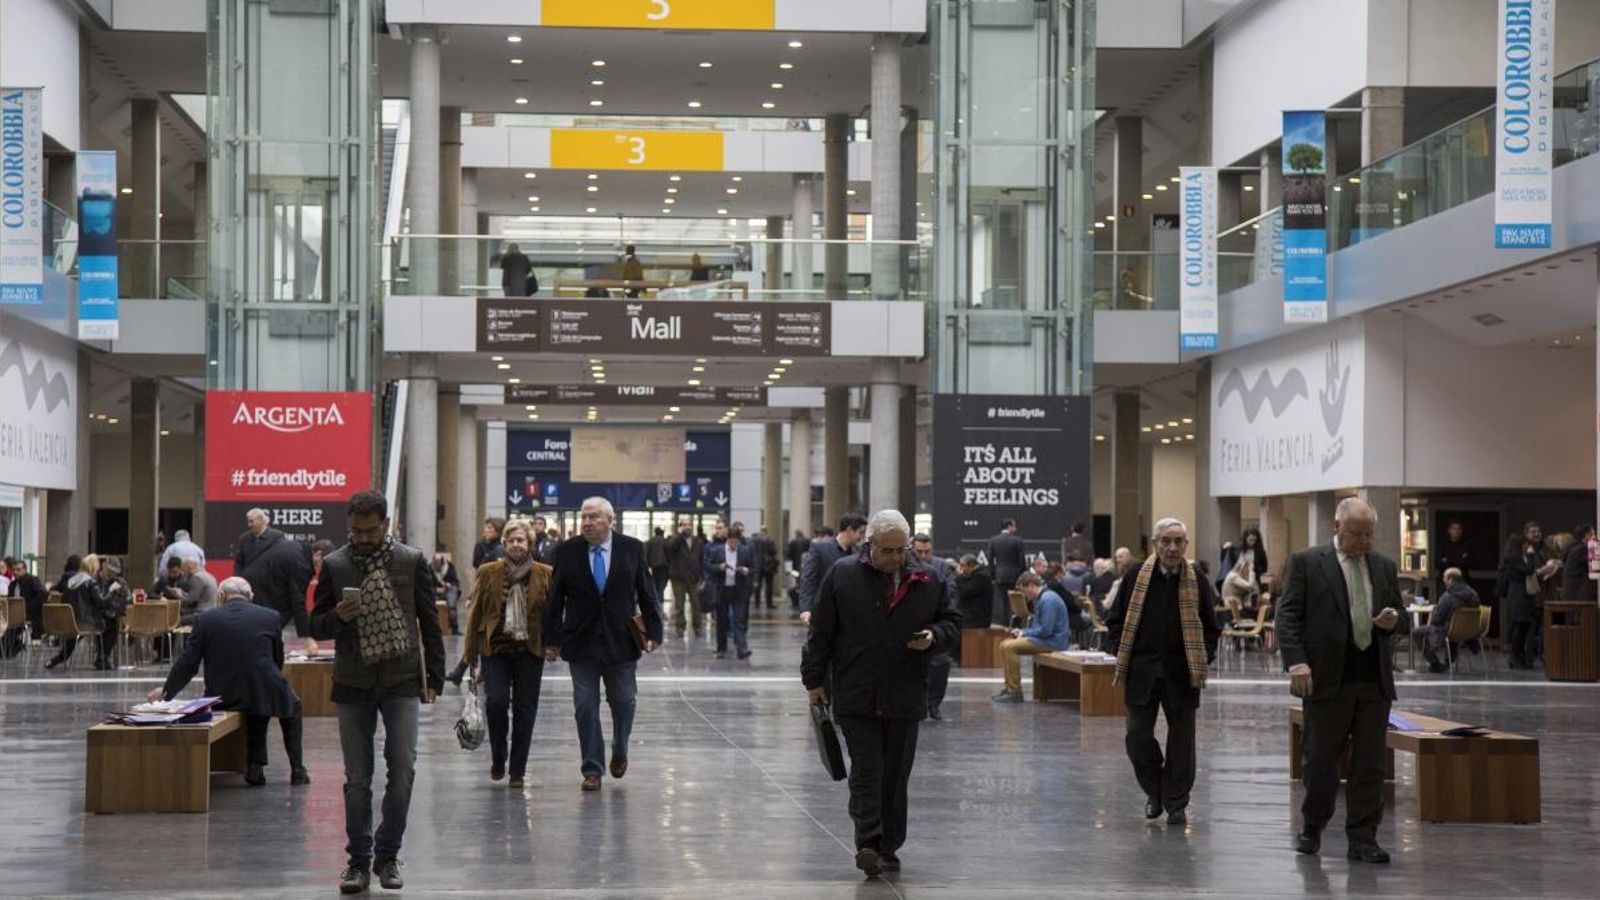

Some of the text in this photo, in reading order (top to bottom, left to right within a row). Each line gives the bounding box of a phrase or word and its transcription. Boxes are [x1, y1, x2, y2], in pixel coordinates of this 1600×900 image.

[3, 91, 24, 228] COLOROBBIA
[628, 136, 646, 164] 3
[1185, 171, 1202, 287] COLOROBBIA
[631, 317, 681, 339] Mall
[232, 402, 344, 432] ARGENTA
[545, 439, 568, 449] Foro
[1221, 431, 1314, 473] FERIA VALENCIA
[526, 451, 566, 460] CENTRAL
[998, 446, 1037, 463] ALL
[963, 467, 1035, 484] ABOUT
[963, 488, 1059, 505] FEELINGS
[272, 508, 323, 525] HERE
